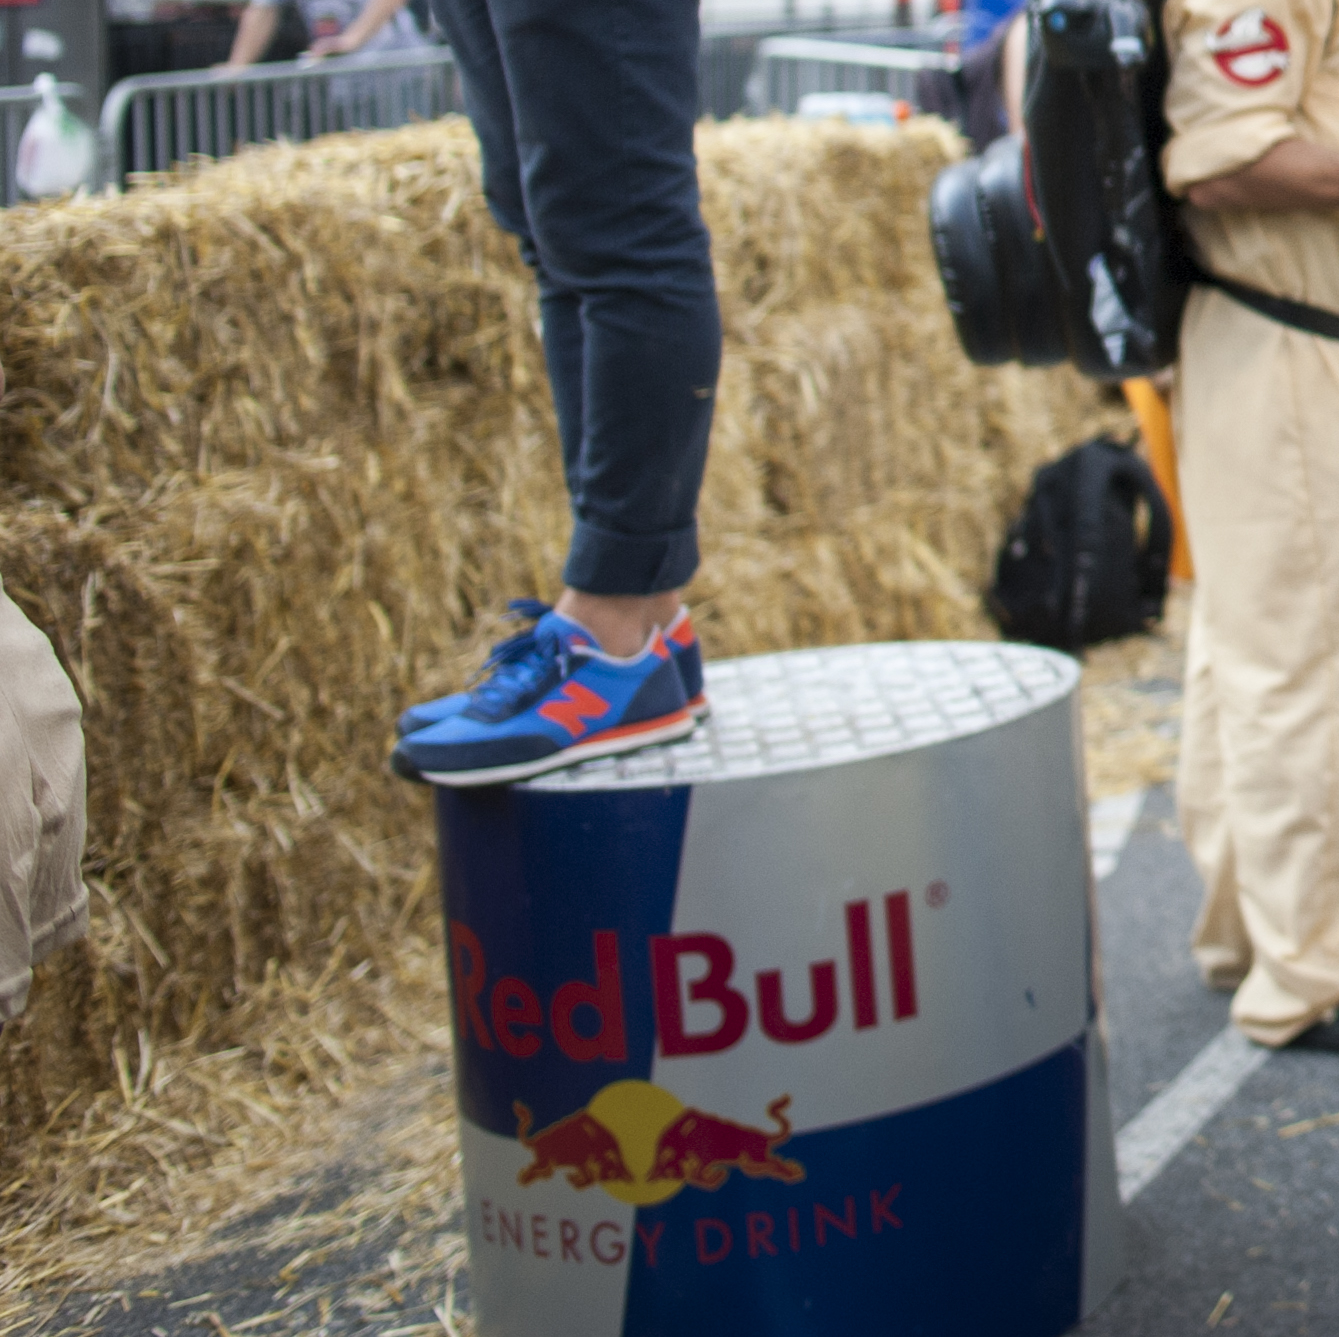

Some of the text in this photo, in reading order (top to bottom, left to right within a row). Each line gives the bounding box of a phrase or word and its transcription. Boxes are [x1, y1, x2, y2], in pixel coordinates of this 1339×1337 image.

[449, 888, 918, 1063] Red Bull
[480, 1183, 903, 1268] ENERGY DRINK
